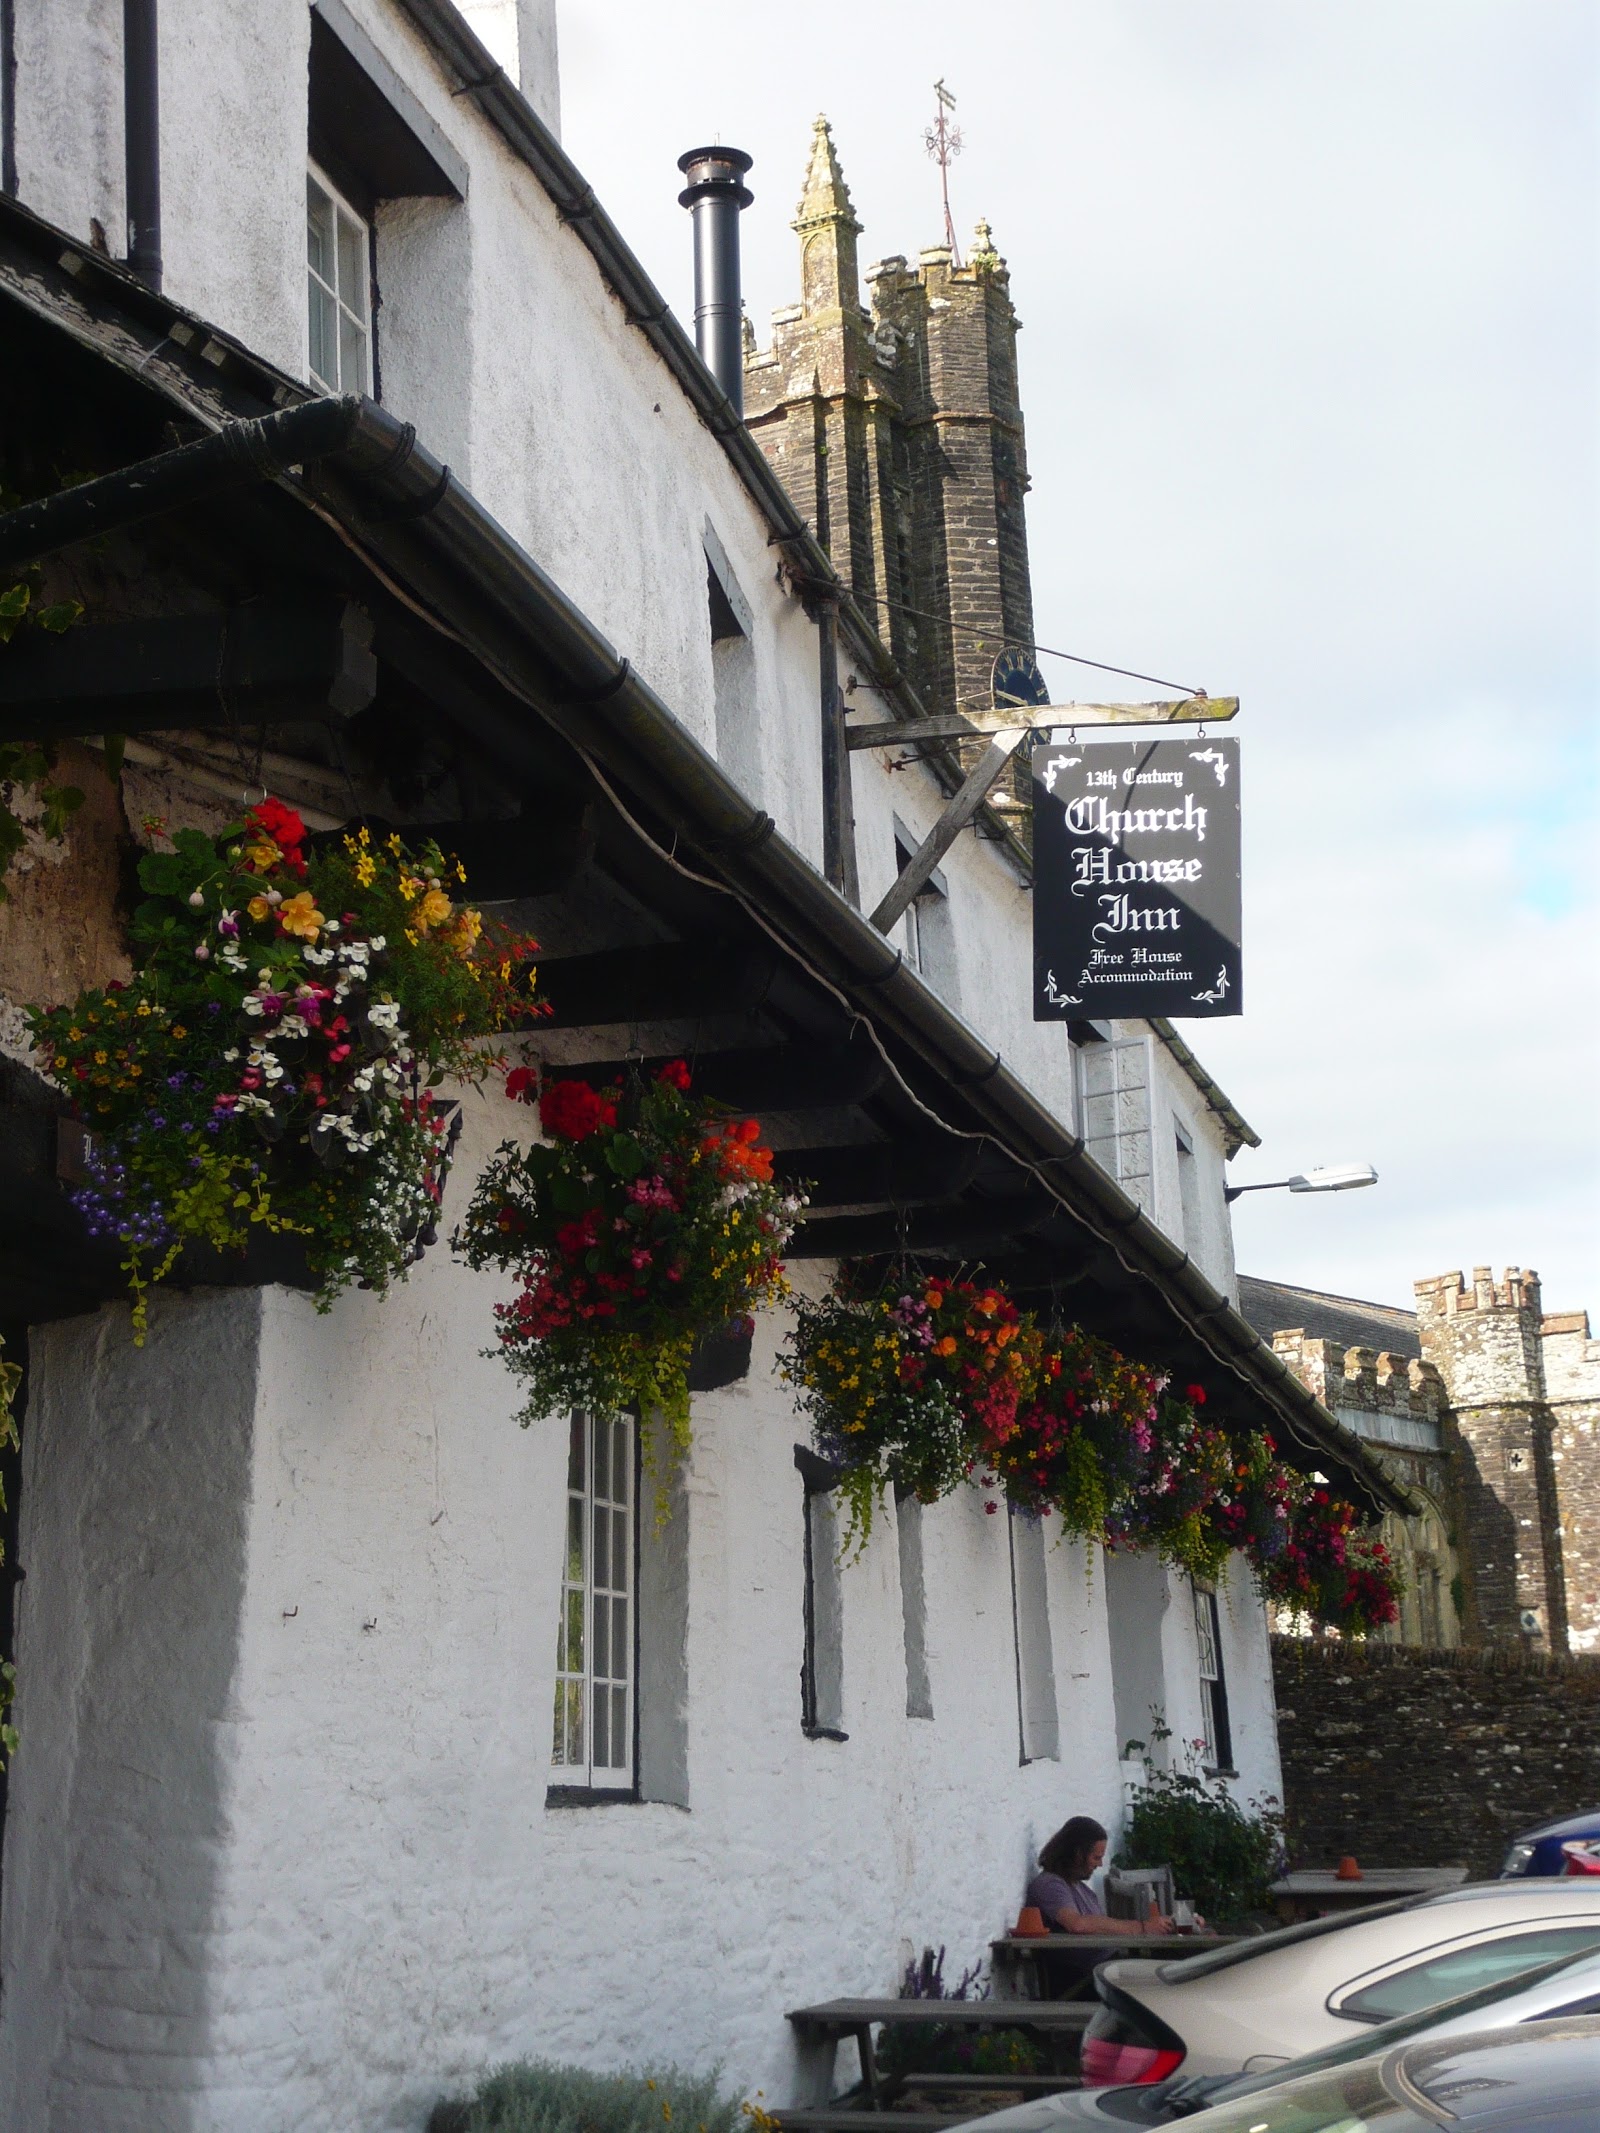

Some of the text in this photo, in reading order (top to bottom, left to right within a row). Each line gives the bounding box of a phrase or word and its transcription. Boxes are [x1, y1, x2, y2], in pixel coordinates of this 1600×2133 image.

[1086, 767, 1184, 790] 13th Century
[1065, 793, 1208, 844] Church
[1071, 847, 1202, 896] House
[1092, 893, 1181, 943] Inn
[1088, 947, 1182, 969] Free House
[1077, 969, 1193, 988] Accommodation
